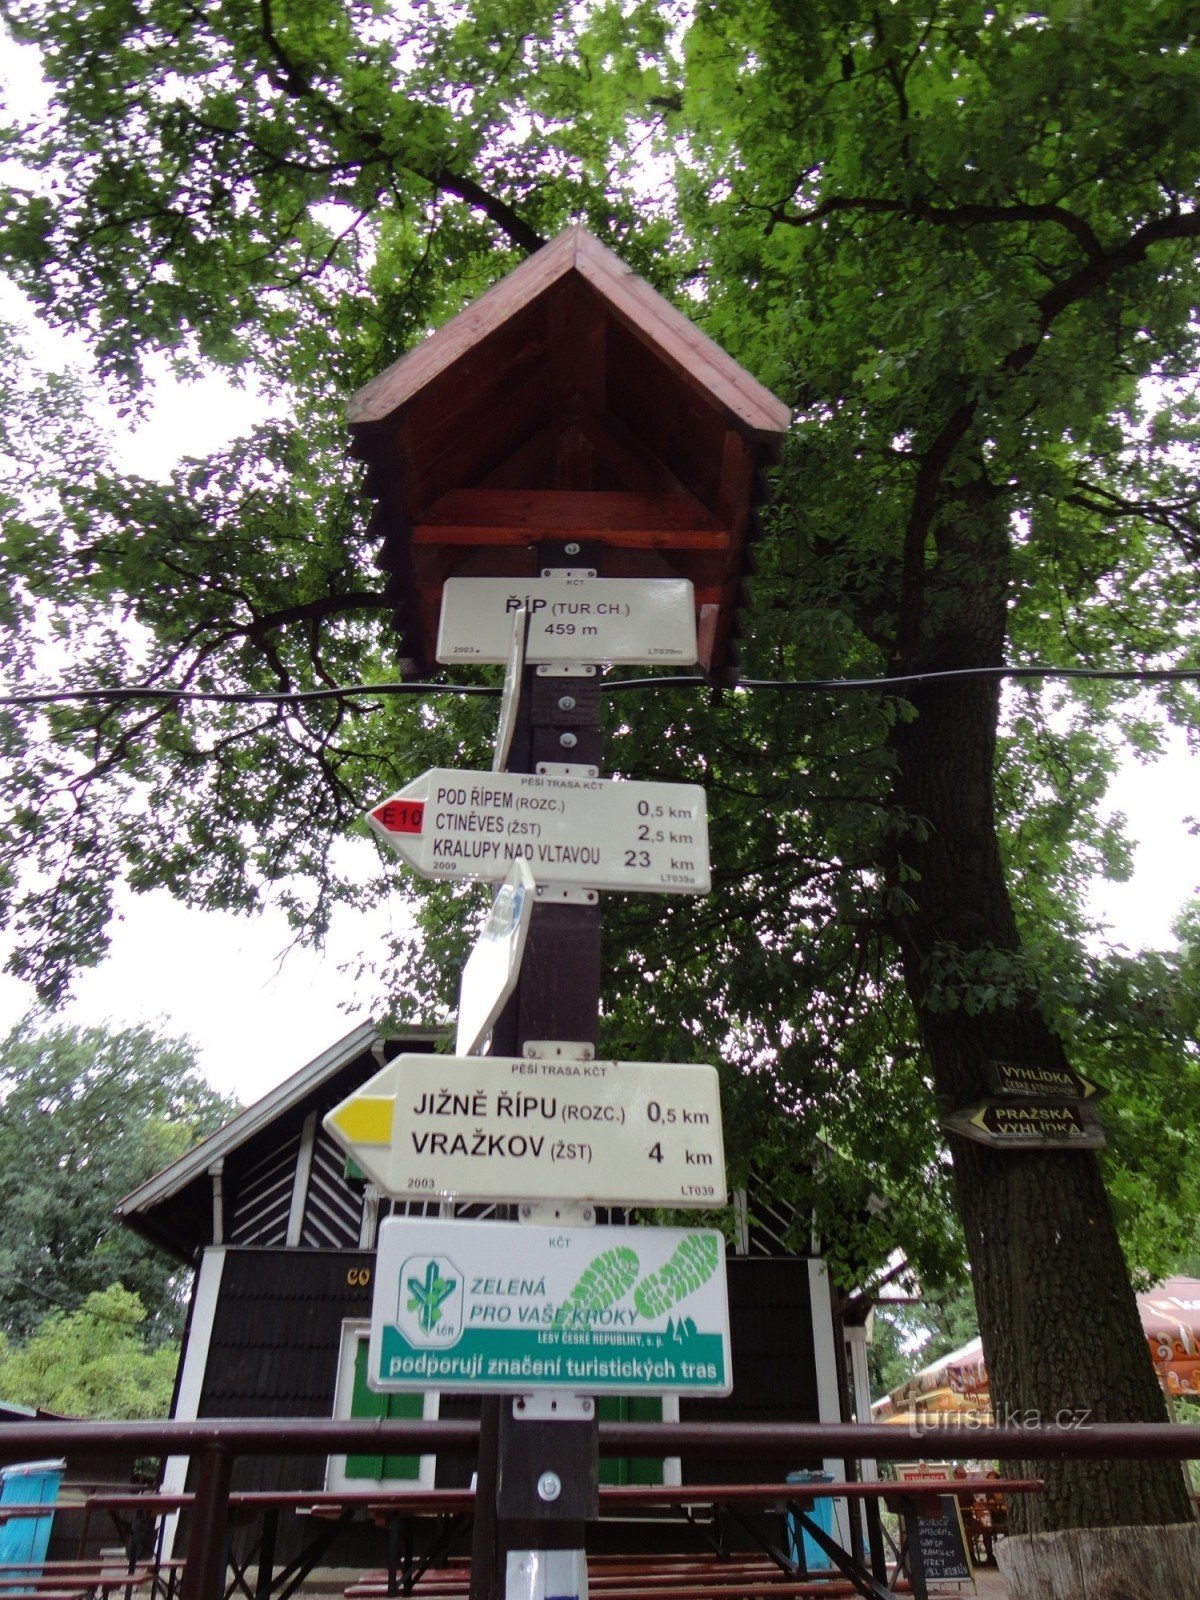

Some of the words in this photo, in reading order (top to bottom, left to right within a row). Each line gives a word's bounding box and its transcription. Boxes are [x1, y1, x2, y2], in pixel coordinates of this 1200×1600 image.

[505, 595, 547, 613] ŘÍP
[552, 603, 630, 618] (TUR.CH.)
[544, 624, 576, 635] 459
[582, 626, 598, 635] m
[546, 779, 580, 789] TRASA
[583, 780, 604, 790] KČT
[437, 788, 466, 806] POD
[470, 786, 514, 809] ŘÍPEM
[515, 799, 565, 814] (ROZC.)
[638, 800, 663, 819] 0,5
[668, 805, 692, 819] km
[435, 811, 504, 833] CTINĚVES
[507, 820, 541, 838] (ŽST)
[638, 825, 664, 844] 2,5
[669, 832, 693, 845] km
[433, 838, 500, 859] KRALUPY
[538, 844, 600, 865] VLTAVOU
[624, 850, 651, 867] 23
[670, 858, 695, 871] km
[433, 861, 457, 870] 2009
[511, 1063, 538, 1075] PĚŠÍ
[541, 1065, 581, 1077] TRASA
[583, 1065, 608, 1078] KČT
[1002, 1066, 1074, 1085] VYHLÍDKA
[413, 1088, 487, 1116] JIŽNĚ
[497, 1090, 557, 1119] ŘÍPU
[562, 1105, 625, 1125] (ROZC.)
[646, 1101, 676, 1125] 0,5
[683, 1109, 709, 1125] km
[411, 1128, 544, 1158] VRAŽKOV
[550, 1142, 592, 1163] (ŽST)
[648, 1143, 664, 1164] 4
[685, 1150, 713, 1166] km
[407, 1178, 435, 1190] 2003
[681, 1185, 714, 1197] LT039
[549, 1236, 571, 1248] KČT
[470, 1276, 546, 1296] ZELENÁ
[469, 1305, 512, 1323] PRO
[518, 1303, 565, 1324] VAŠE
[572, 1308, 639, 1326] KROKY
[538, 1332, 559, 1344] LESY
[562, 1331, 590, 1345] ČESKÉ
[389, 1350, 482, 1378] podporují
[487, 1355, 561, 1376] značení
[566, 1357, 676, 1381] turistických
[680, 1362, 717, 1379] tras
